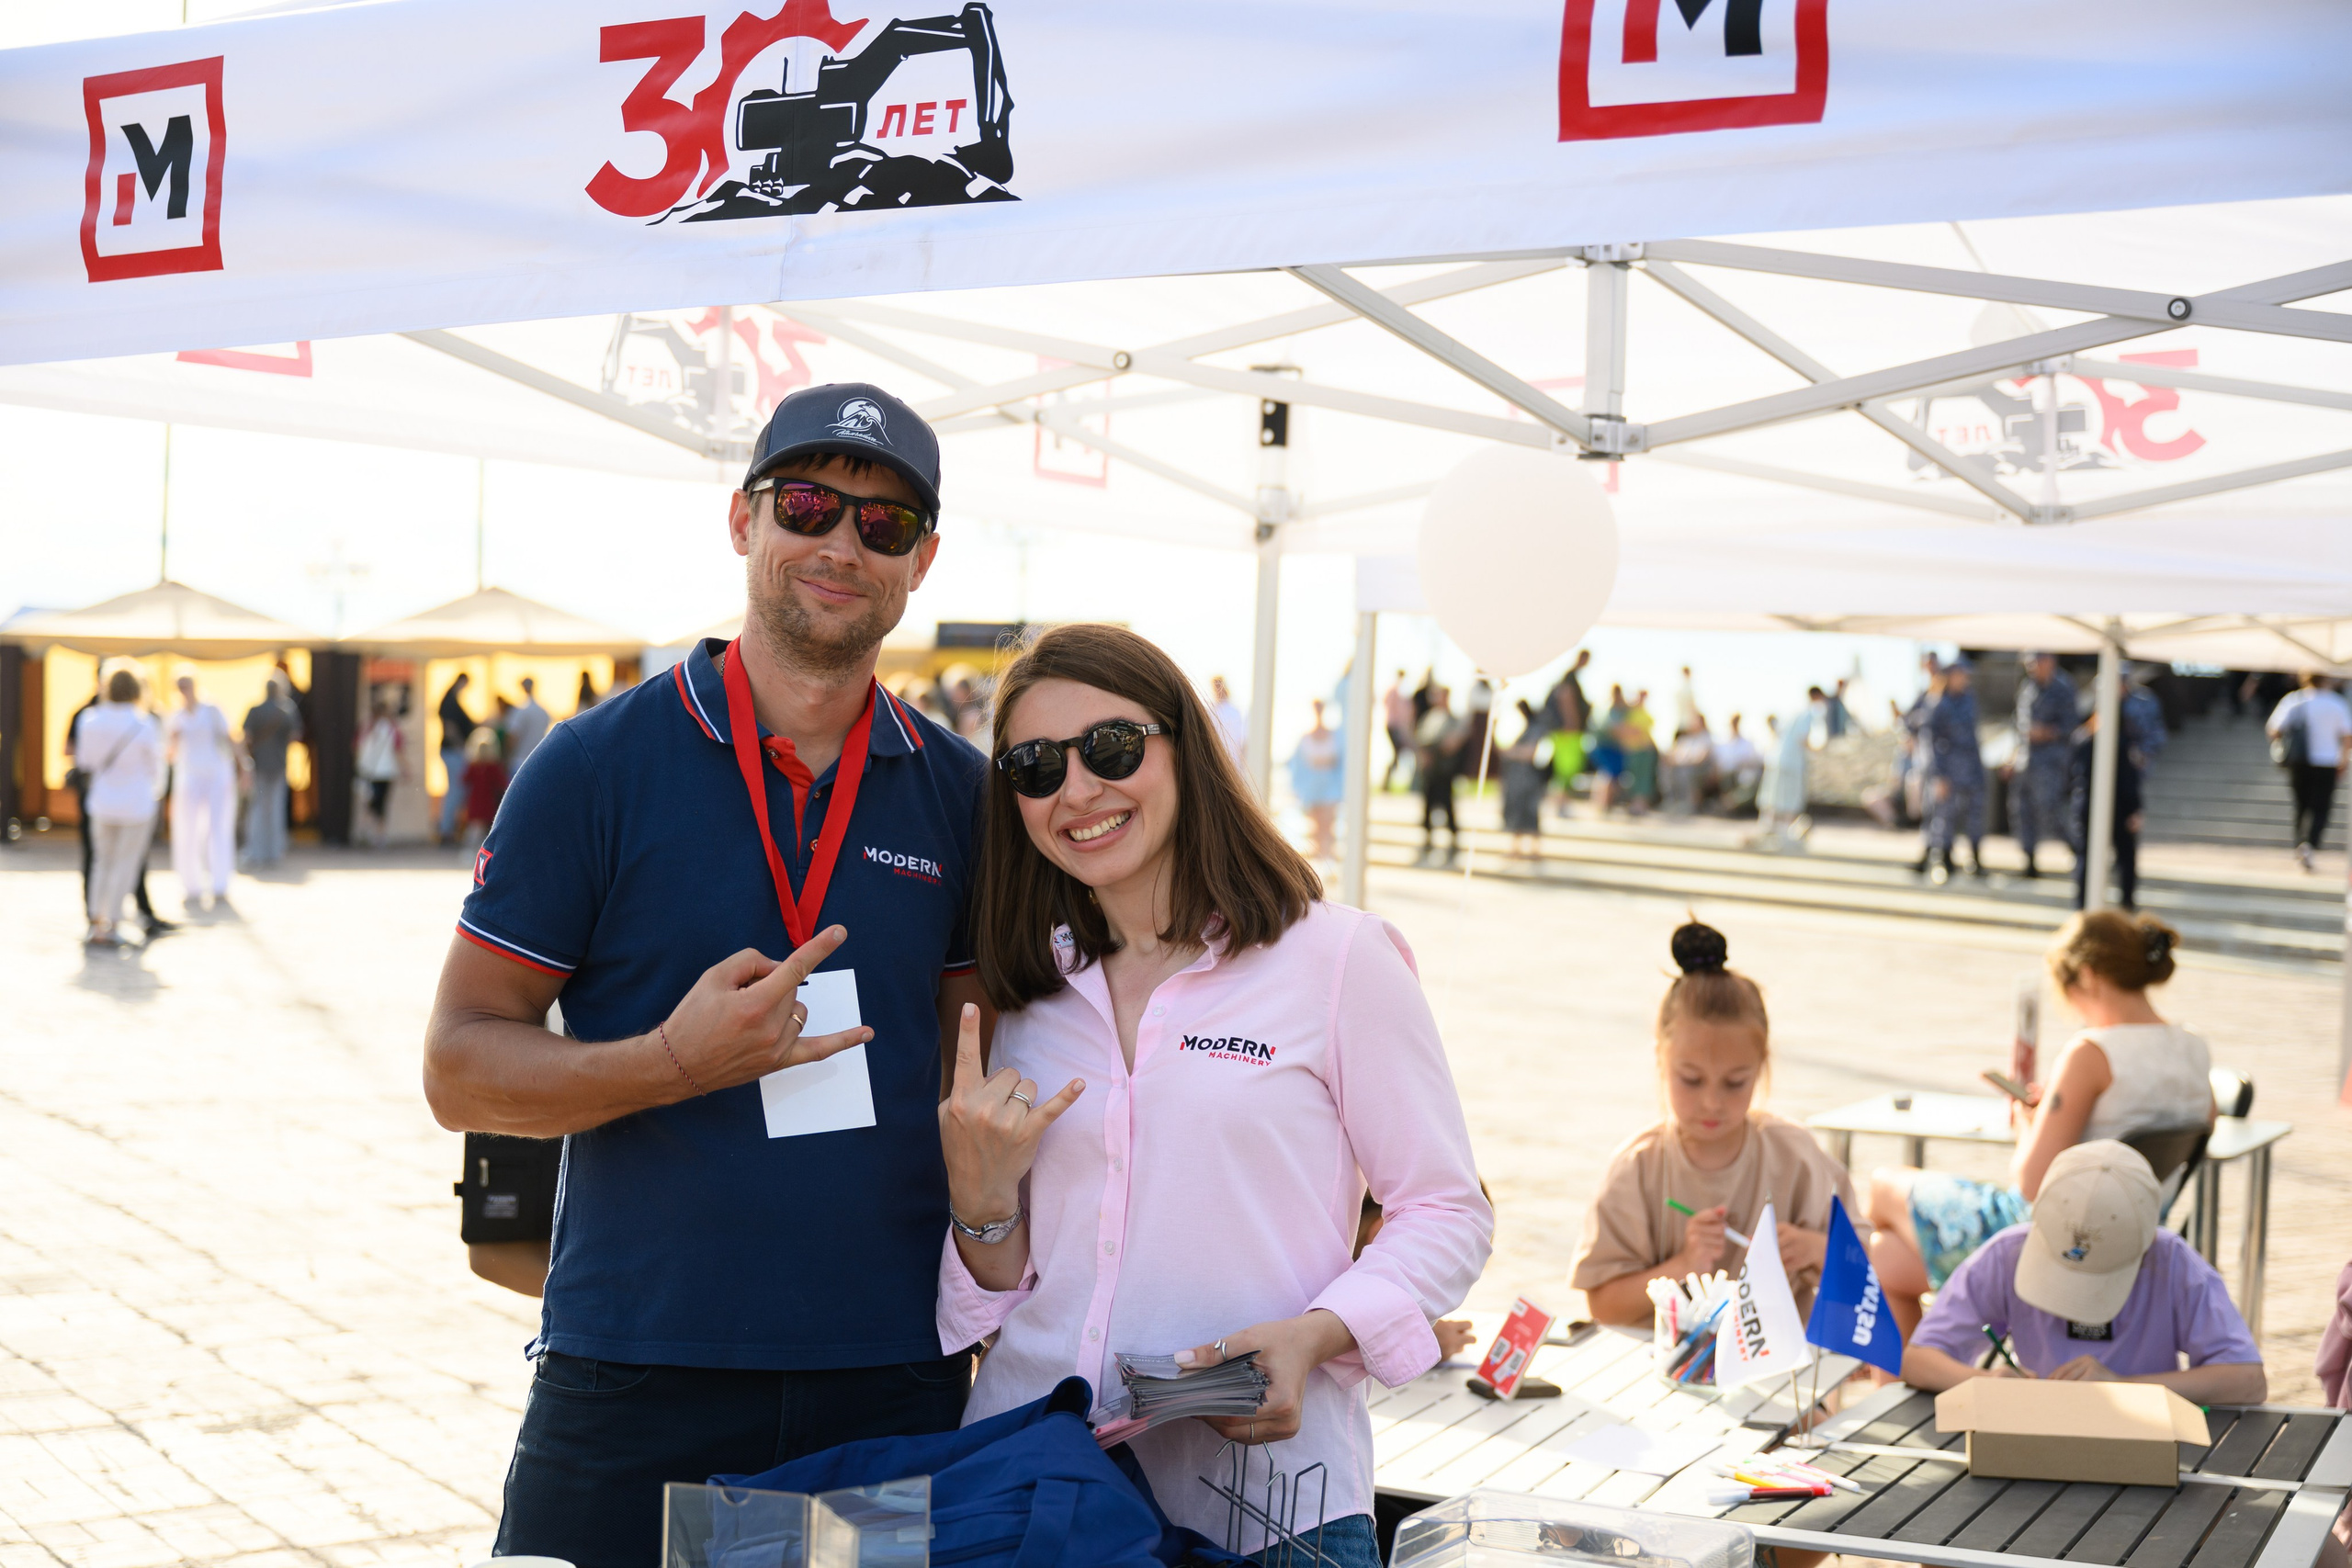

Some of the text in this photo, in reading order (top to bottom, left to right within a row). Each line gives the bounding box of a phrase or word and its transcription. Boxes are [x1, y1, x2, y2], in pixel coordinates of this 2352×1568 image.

[876, 98, 967, 139] ЛЕТ
[863, 845, 943, 878] MODERN
[1180, 1034, 1277, 1061] MODERN
[1208, 1051, 1272, 1067] MACHINERY
[1738, 1262, 1770, 1359] ODERN
